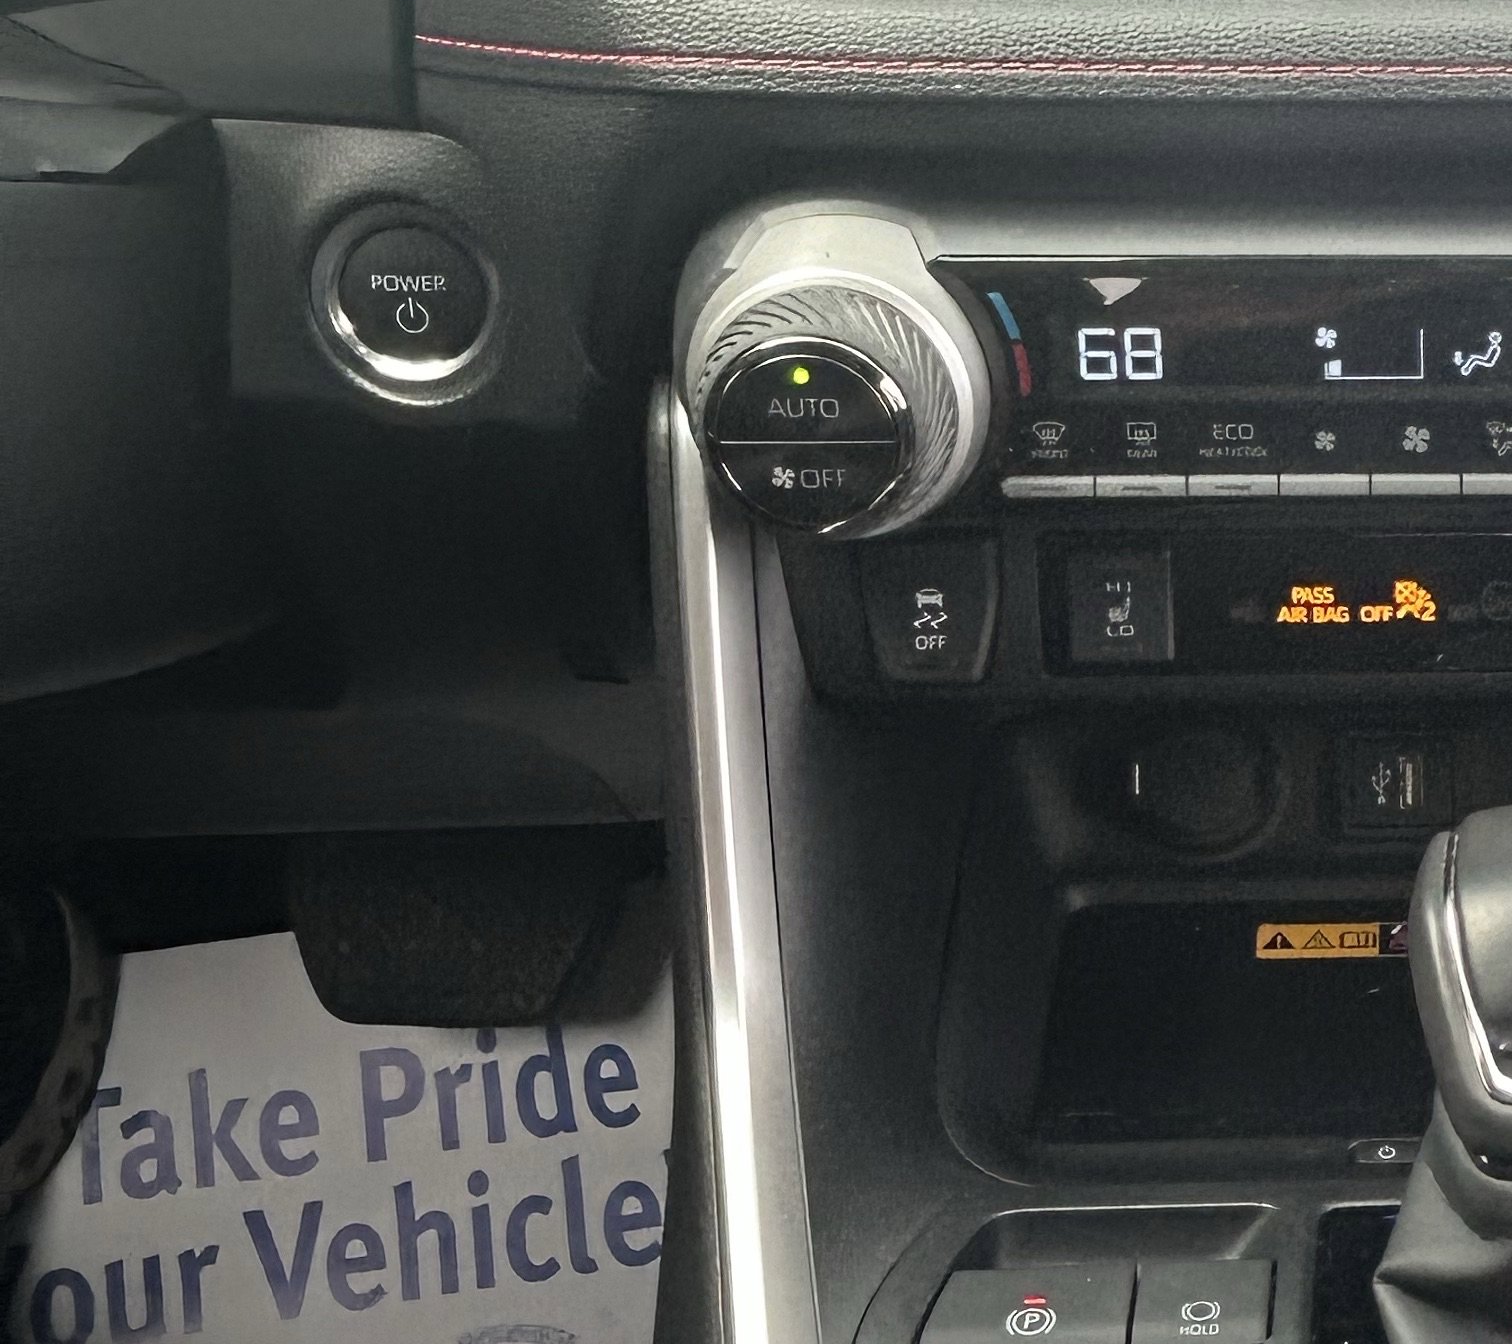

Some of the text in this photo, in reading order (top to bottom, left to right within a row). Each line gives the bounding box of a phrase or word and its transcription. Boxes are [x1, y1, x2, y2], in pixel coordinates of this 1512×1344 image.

[370, 274, 447, 293] POWER
[1077, 326, 1164, 381] 68
[767, 397, 840, 419] AUTO
[1213, 423, 1254, 441] ECO
[800, 468, 847, 490] OFF
[1290, 585, 1336, 605] PASS
[1276, 605, 1394, 624] AIR BAG OFF
[915, 635, 948, 651] OFF
[78, 1022, 641, 1205] Take Pride
[244, 1152, 663, 1322] Vehicle
[1023, 1312, 1041, 1329] P
[1179, 1323, 1220, 1336] HOLD
